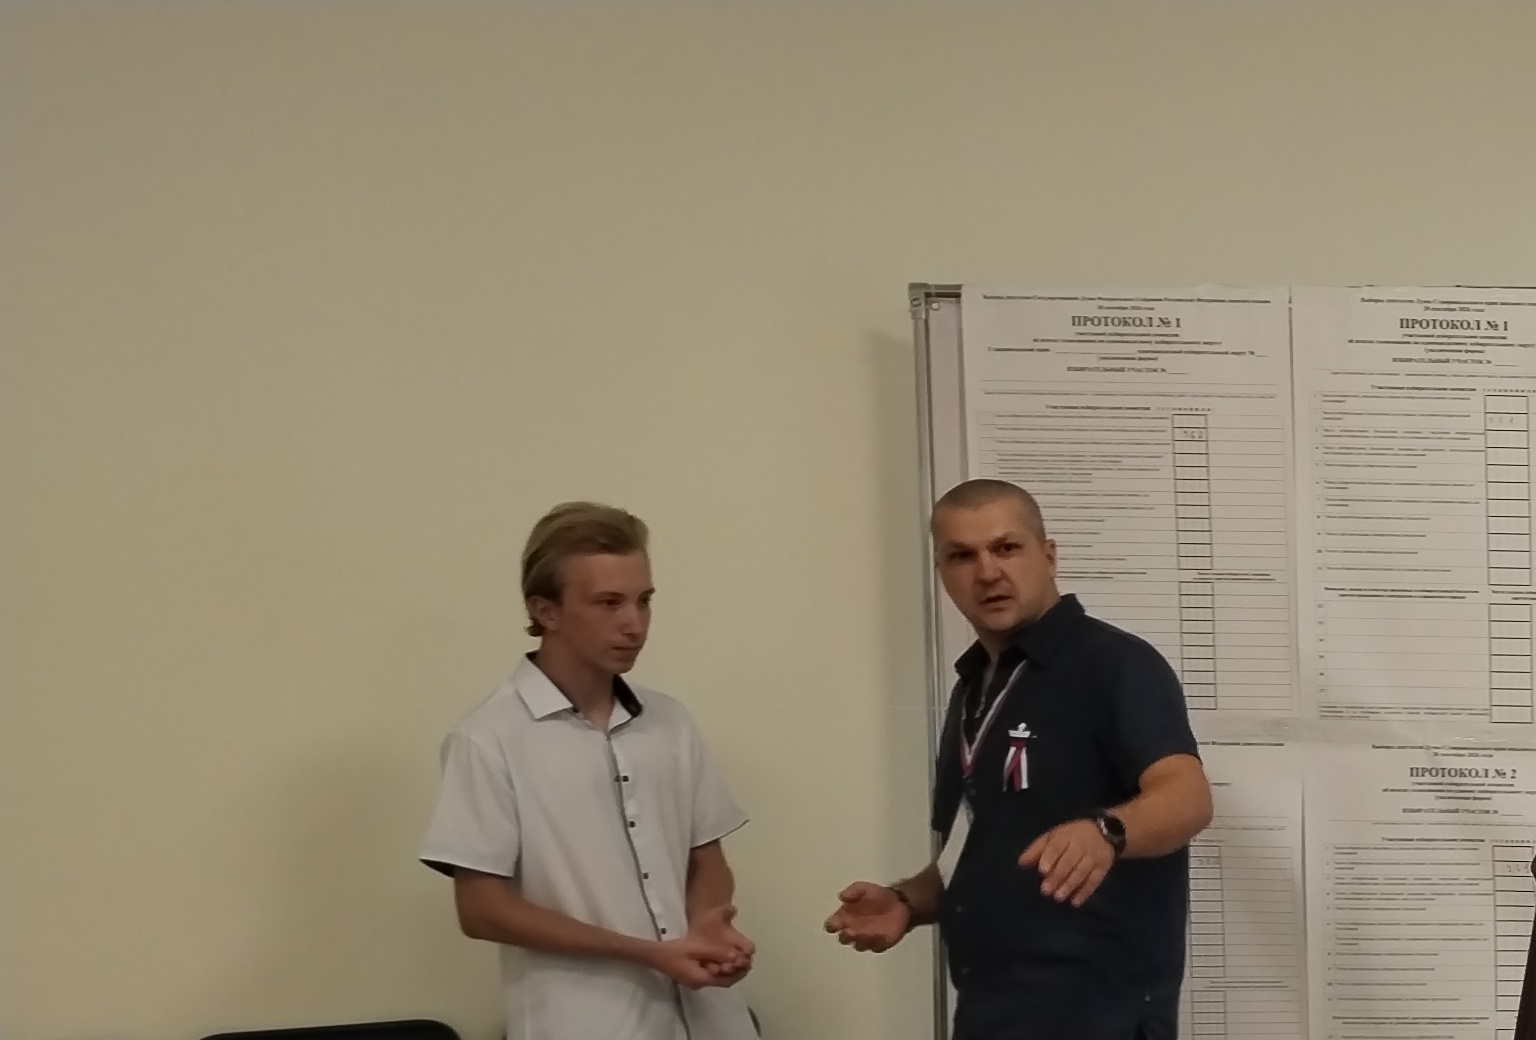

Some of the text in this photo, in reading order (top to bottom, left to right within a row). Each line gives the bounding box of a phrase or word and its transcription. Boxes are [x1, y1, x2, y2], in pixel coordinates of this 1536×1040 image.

[1071, 315, 1182, 328] ПРОТОКОЛ № 1
[1399, 318, 1509, 331] ПРОТОКОЛ № 1
[1409, 766, 1518, 779] ПРОТОКОЛ № 2
